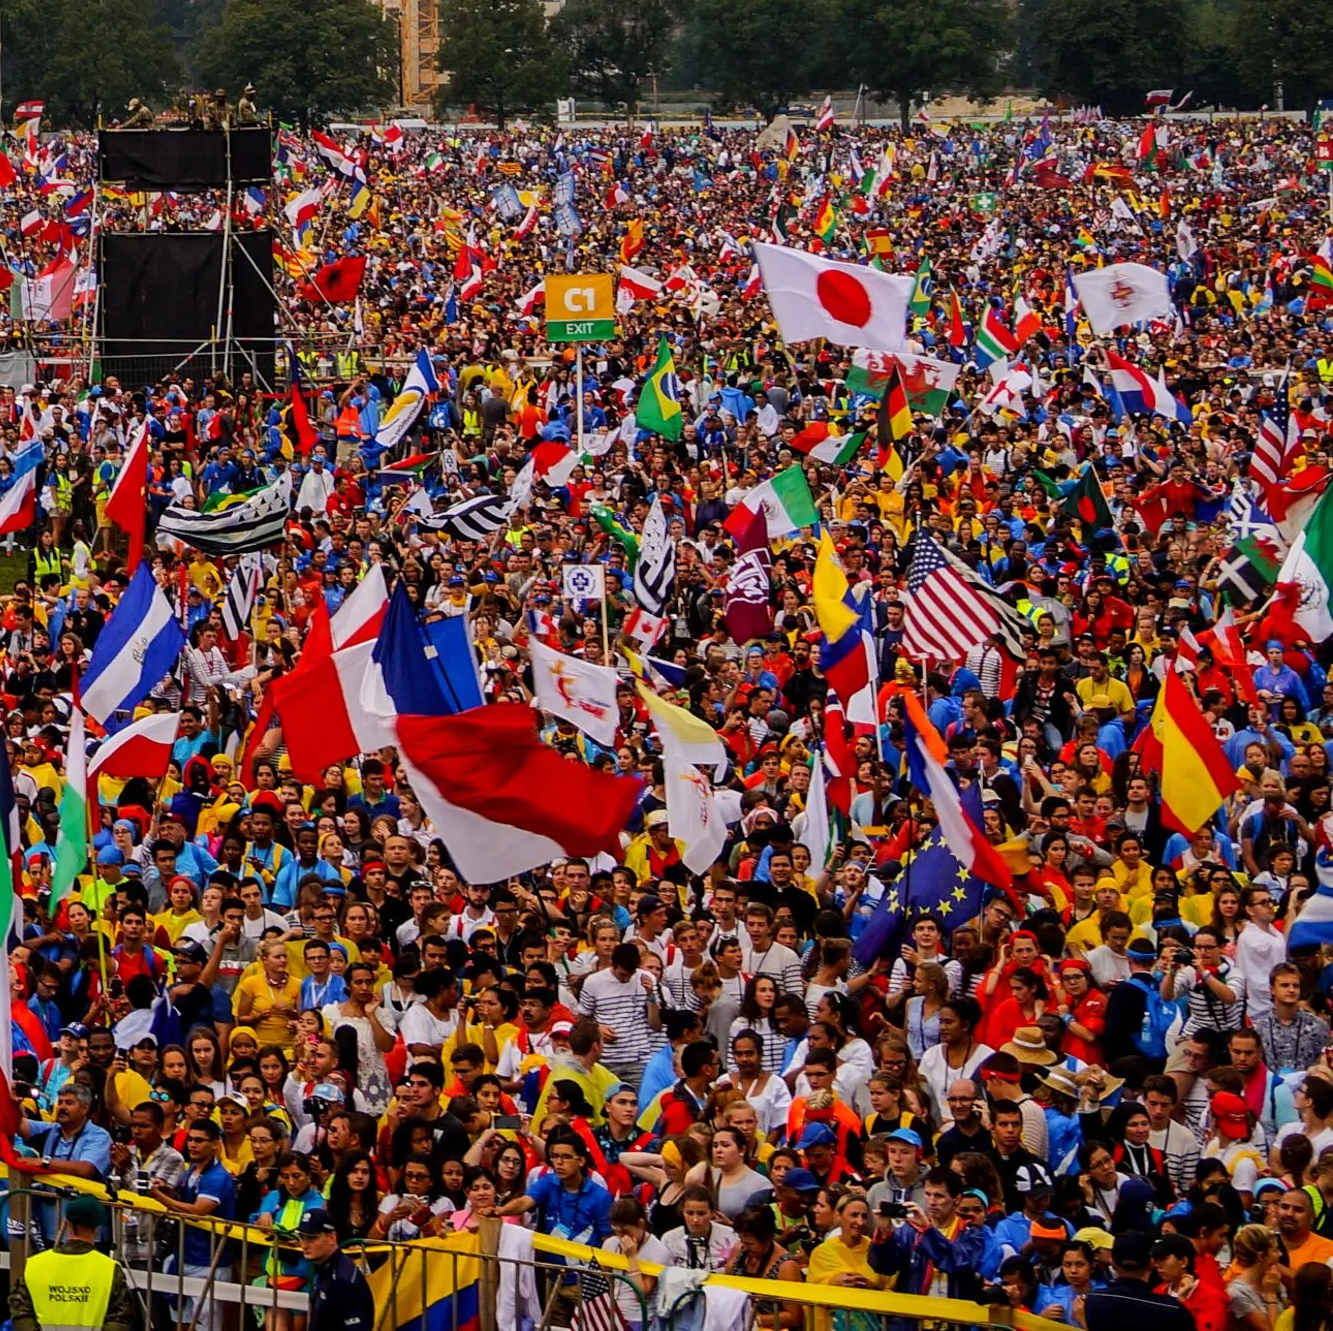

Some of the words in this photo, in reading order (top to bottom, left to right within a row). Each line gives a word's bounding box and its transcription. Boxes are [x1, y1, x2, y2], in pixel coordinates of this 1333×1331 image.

[564, 287, 595, 312] C1
[565, 323, 594, 335] EXIT
[49, 1285, 91, 1294] WOJSKO
[49, 1294, 90, 1303] POLSKIE
